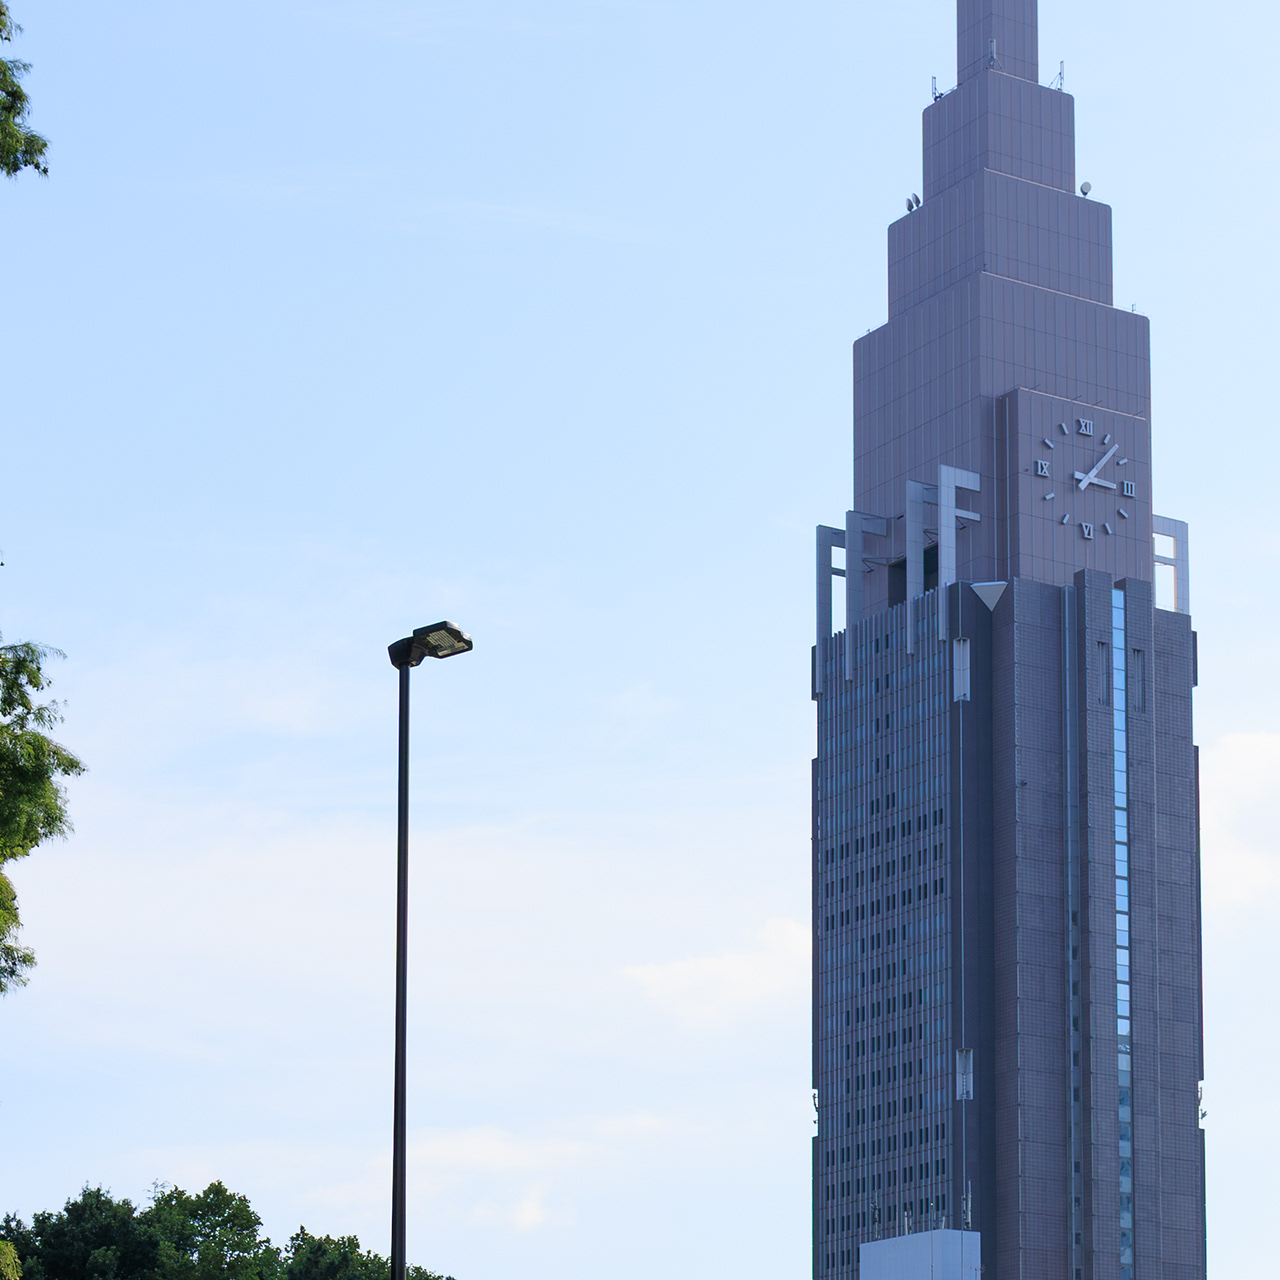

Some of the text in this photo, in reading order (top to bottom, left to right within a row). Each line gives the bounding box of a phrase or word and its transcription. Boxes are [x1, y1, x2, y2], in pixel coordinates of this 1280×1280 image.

[1078, 418, 1094, 436] XII
[1037, 460, 1050, 477] IX
[1123, 480, 1136, 498] III
[1080, 522, 1094, 540] VI
